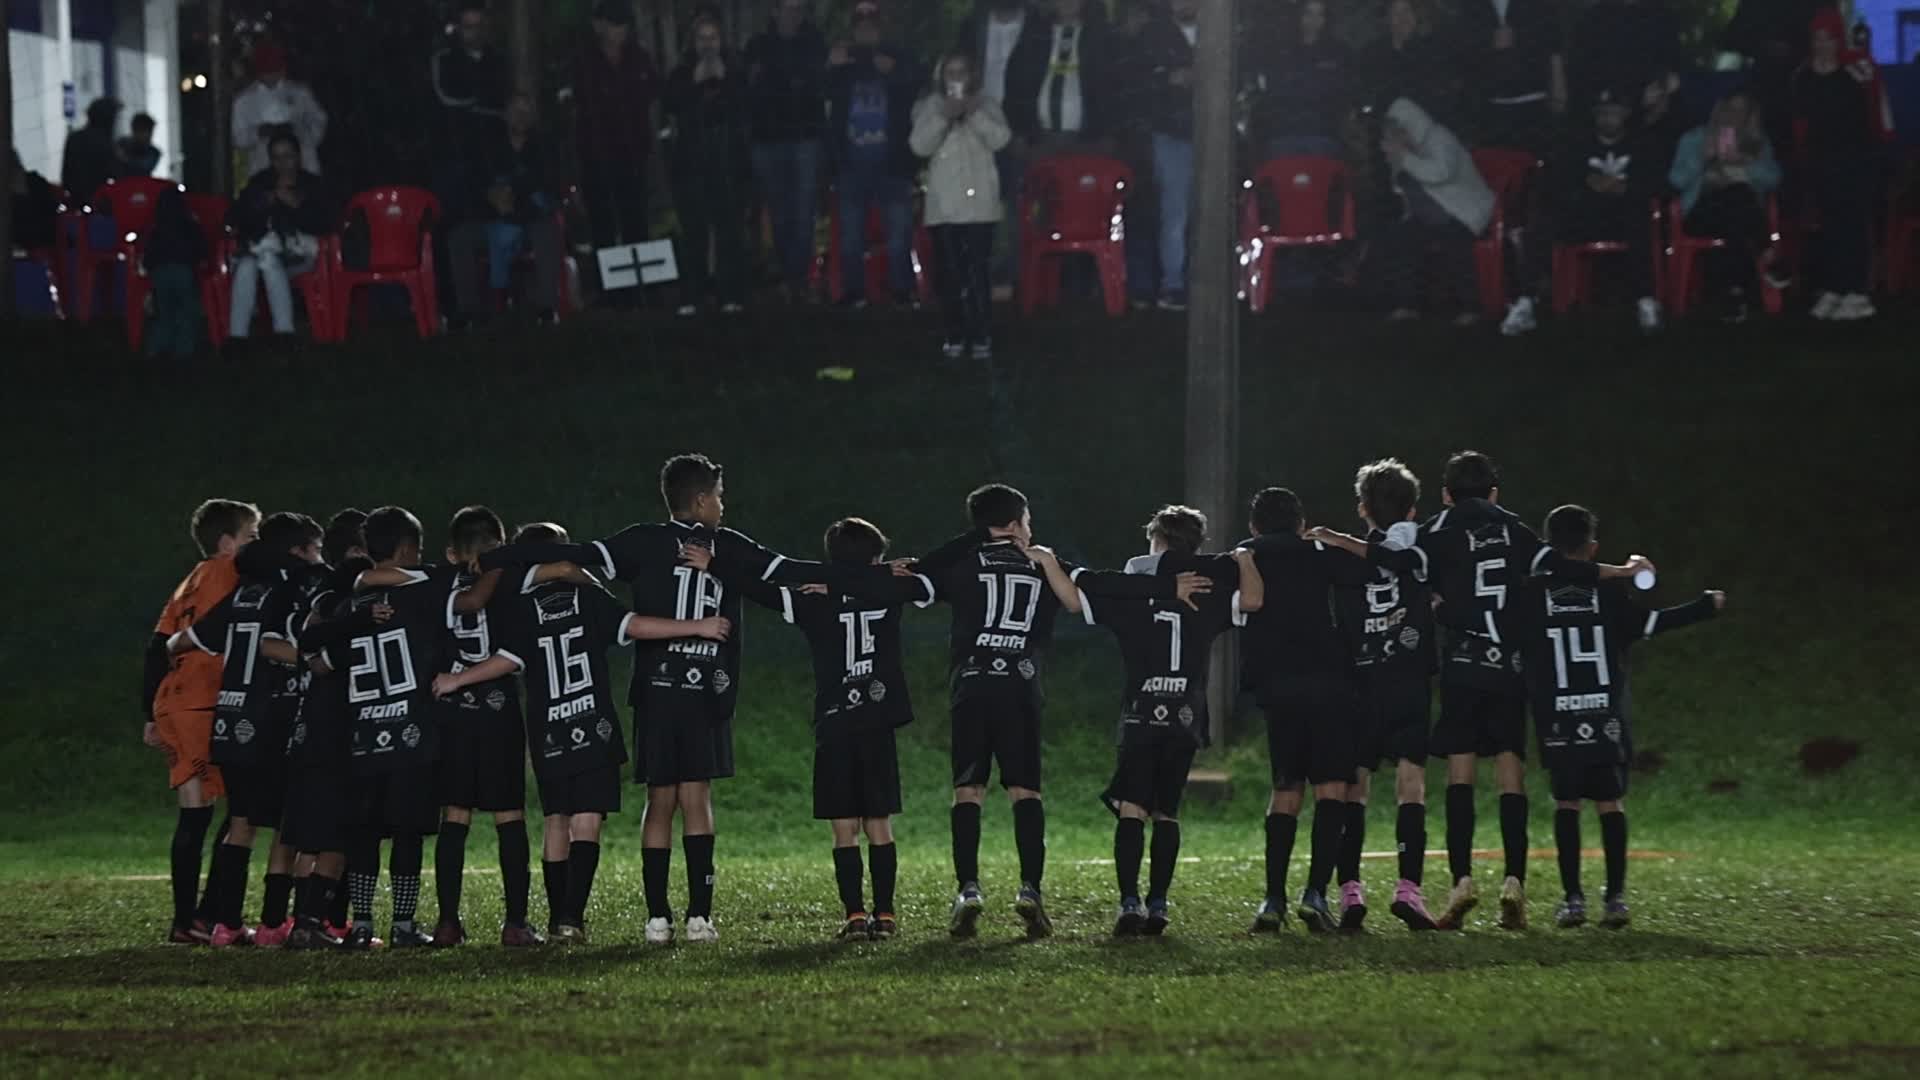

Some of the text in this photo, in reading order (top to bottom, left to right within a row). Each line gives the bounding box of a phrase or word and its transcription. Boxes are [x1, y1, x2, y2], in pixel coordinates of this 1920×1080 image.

[978, 573, 1042, 632] 10
[976, 633, 1026, 649] ROMA
[1153, 610, 1181, 671] 7
[349, 628, 417, 703] 20
[537, 625, 593, 700] 16
[848, 659, 873, 678] MA
[1546, 625, 1611, 688] 14
[1141, 676, 1188, 692] ROMA
[217, 690, 248, 707] OMA
[358, 700, 408, 720] ROMA
[547, 693, 595, 722] ROMA
[1555, 693, 1609, 711] ROMA
